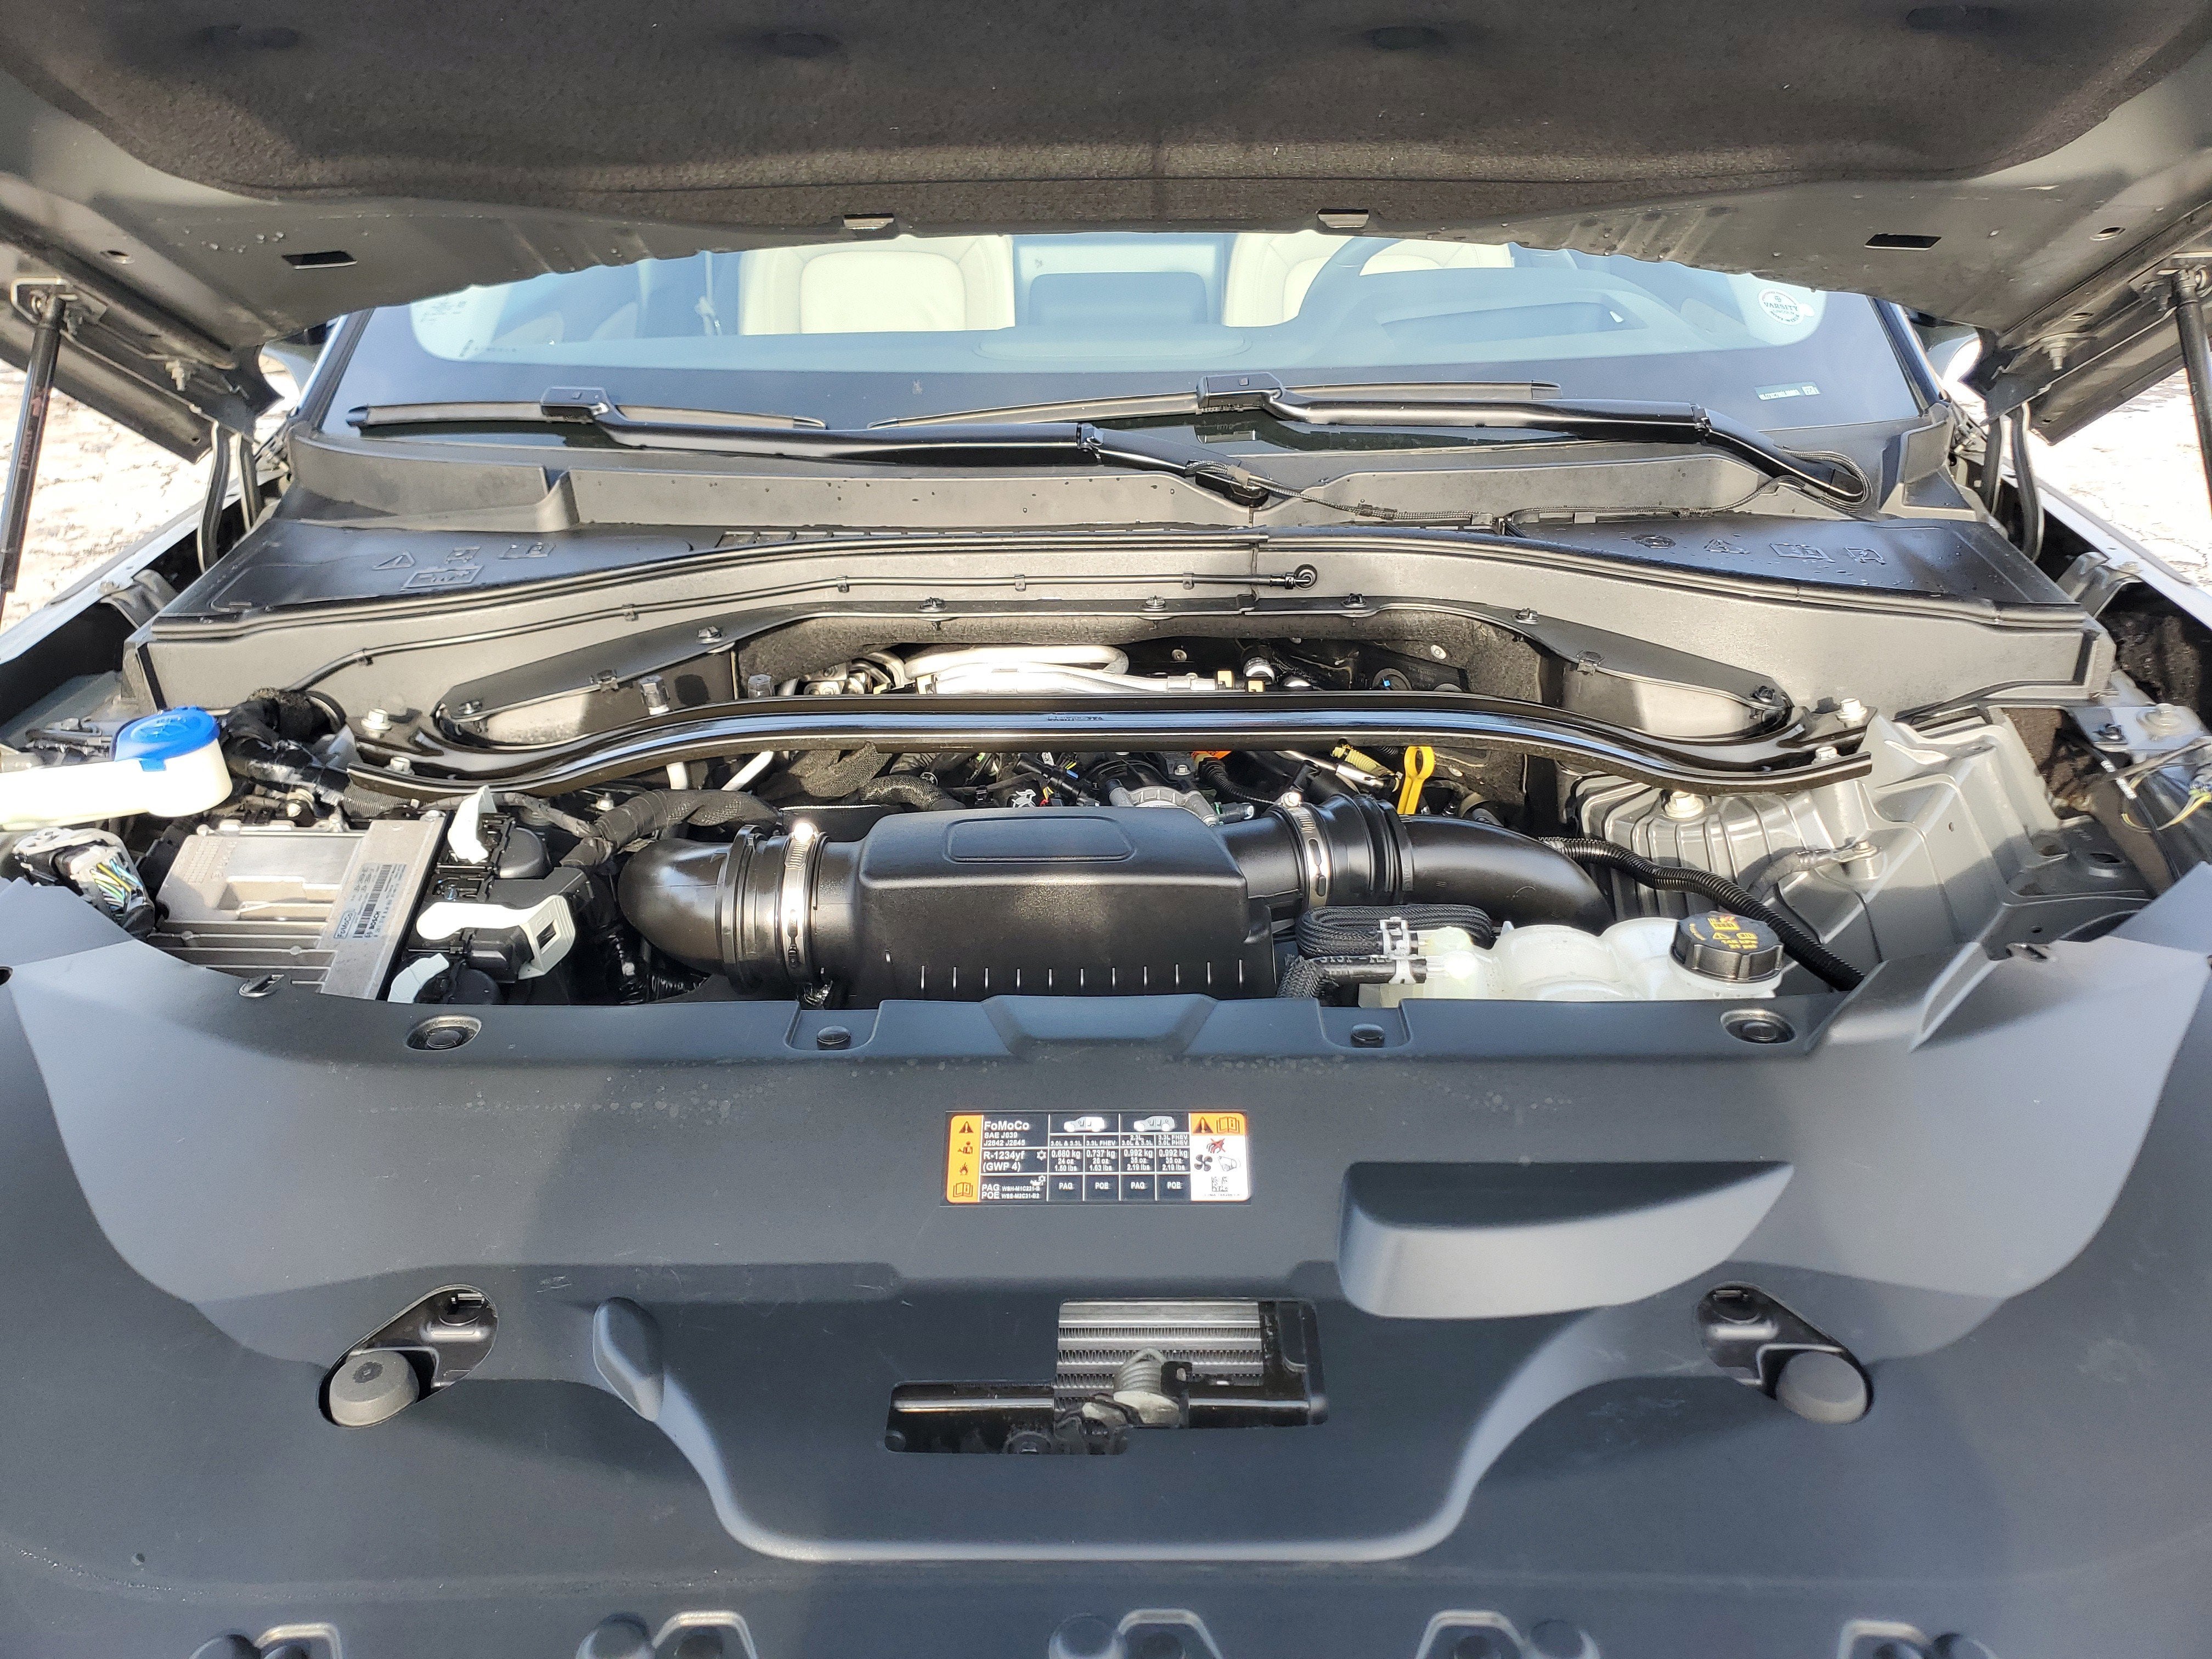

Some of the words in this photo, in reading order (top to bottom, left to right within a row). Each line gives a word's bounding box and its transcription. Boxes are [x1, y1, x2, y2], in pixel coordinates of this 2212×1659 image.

[1764, 302, 1798, 311] VARSITY
[369, 911, 381, 929] BOSCH
[984, 1120, 1030, 1131] FoMoCo
[984, 1150, 1025, 1161] R-1234yf
[1071, 1149, 1081, 1159] kg
[1106, 1149, 1115, 1159] kg
[1144, 1149, 1153, 1158] kg
[1179, 1149, 1188, 1158] kg
[983, 1161, 1009, 1172] (GWP
[1011, 1161, 1021, 1172] 4)
[981, 1183, 1000, 1192] PAG
